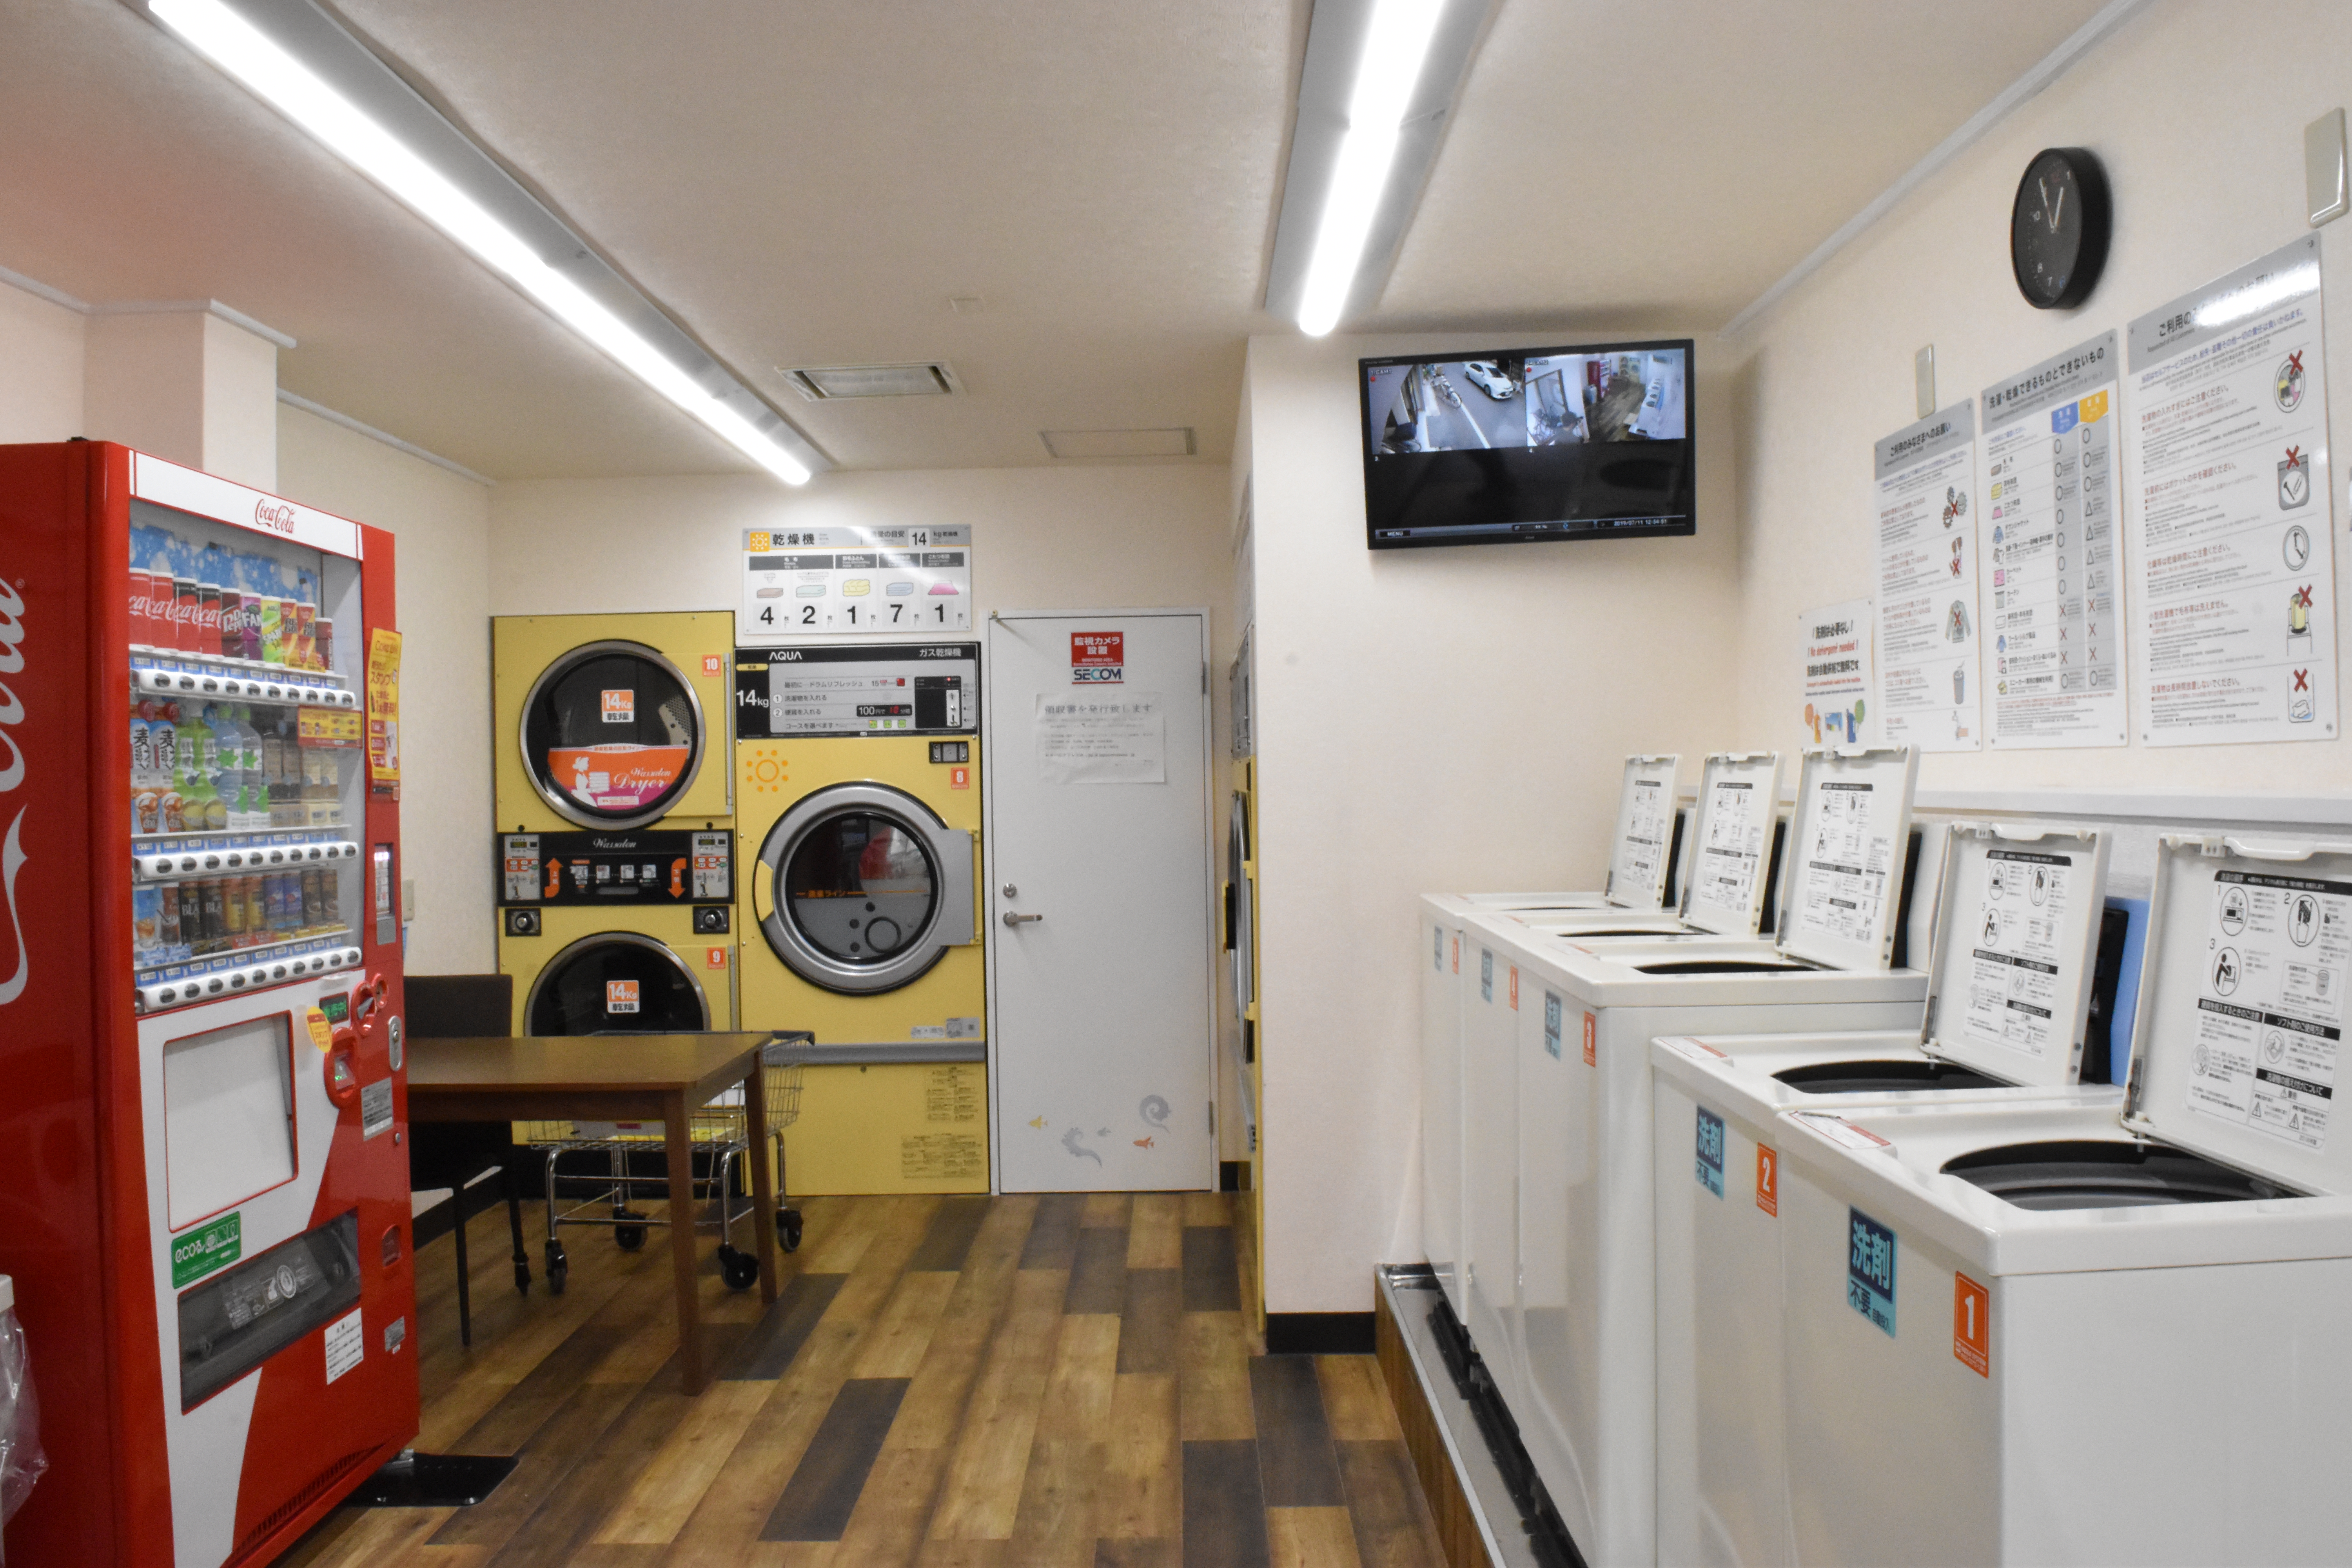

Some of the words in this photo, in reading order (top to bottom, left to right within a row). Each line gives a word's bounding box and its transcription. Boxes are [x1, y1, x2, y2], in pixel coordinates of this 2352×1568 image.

[1989, 345, 2104, 410] 洗濯・乾燥できるものとできないもの
[254, 498, 295, 534] Coca-Cola
[772, 533, 815, 545] 乾燥機
[912, 532, 927, 546] 14
[760, 606, 774, 624] 4
[802, 606, 816, 624] 2
[847, 606, 856, 624] 1
[890, 604, 903, 622] 7
[935, 604, 944, 622] 1
[1074, 637, 1120, 646] 監視カメラ
[769, 651, 802, 661] AQUA
[919, 648, 961, 657] ガス乾燥機
[705, 658, 718, 670] 10
[1074, 668, 1122, 680] SECOM
[736, 690, 769, 708] 14kg
[858, 707, 875, 715] 100
[613, 773, 667, 795] Dryer
[956, 770, 964, 783] 8
[712, 951, 720, 963] 9
[1697, 1115, 1722, 1164] 洗剤
[1762, 1157, 1771, 1193] 2
[1851, 1219, 1891, 1290] 洗剤
[1849, 1279, 1871, 1318] 不要
[1965, 1294, 1975, 1340] 1
